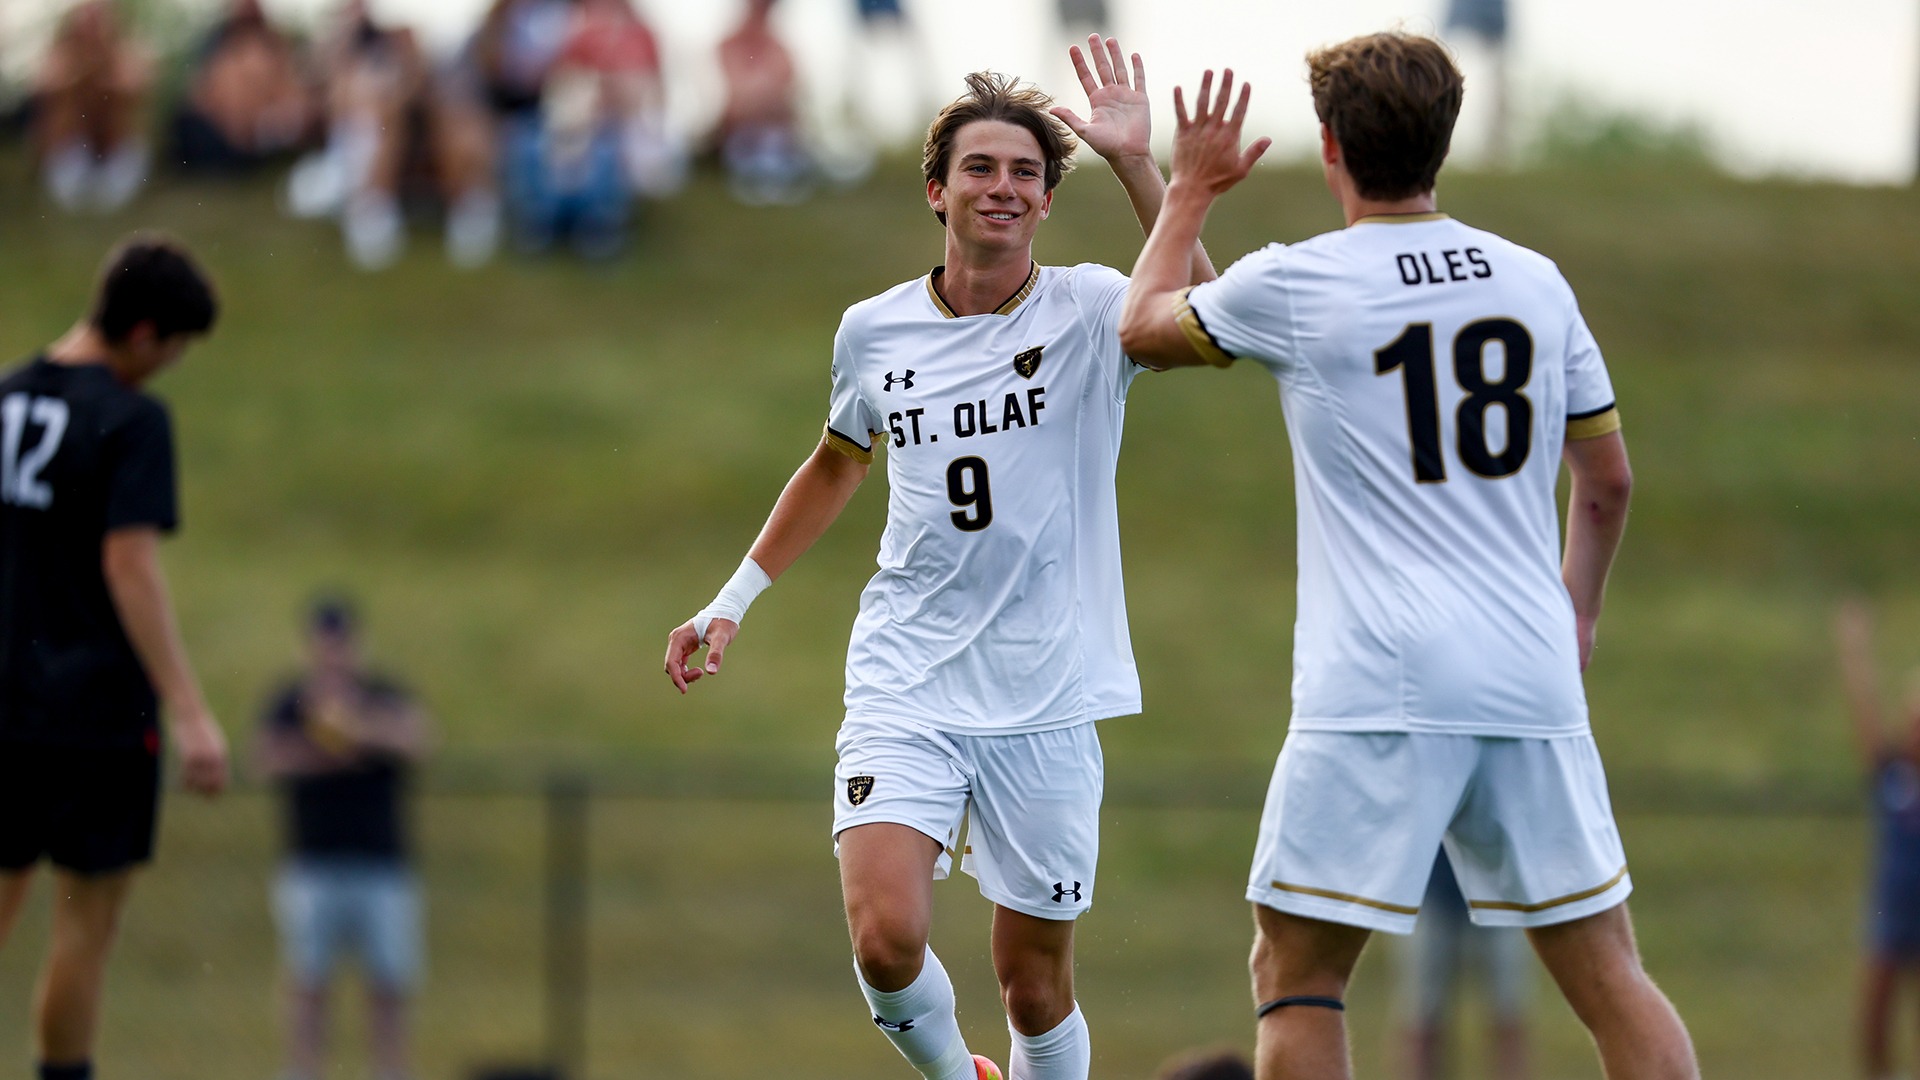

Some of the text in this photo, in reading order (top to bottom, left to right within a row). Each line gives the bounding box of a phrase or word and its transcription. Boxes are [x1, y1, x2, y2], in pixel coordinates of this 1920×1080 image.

[1396, 247, 1492, 286] OLES
[888, 387, 1045, 448] ST. OLAF
[1374, 316, 1535, 484] 18
[1, 391, 69, 511] 12
[945, 455, 993, 532] 9
